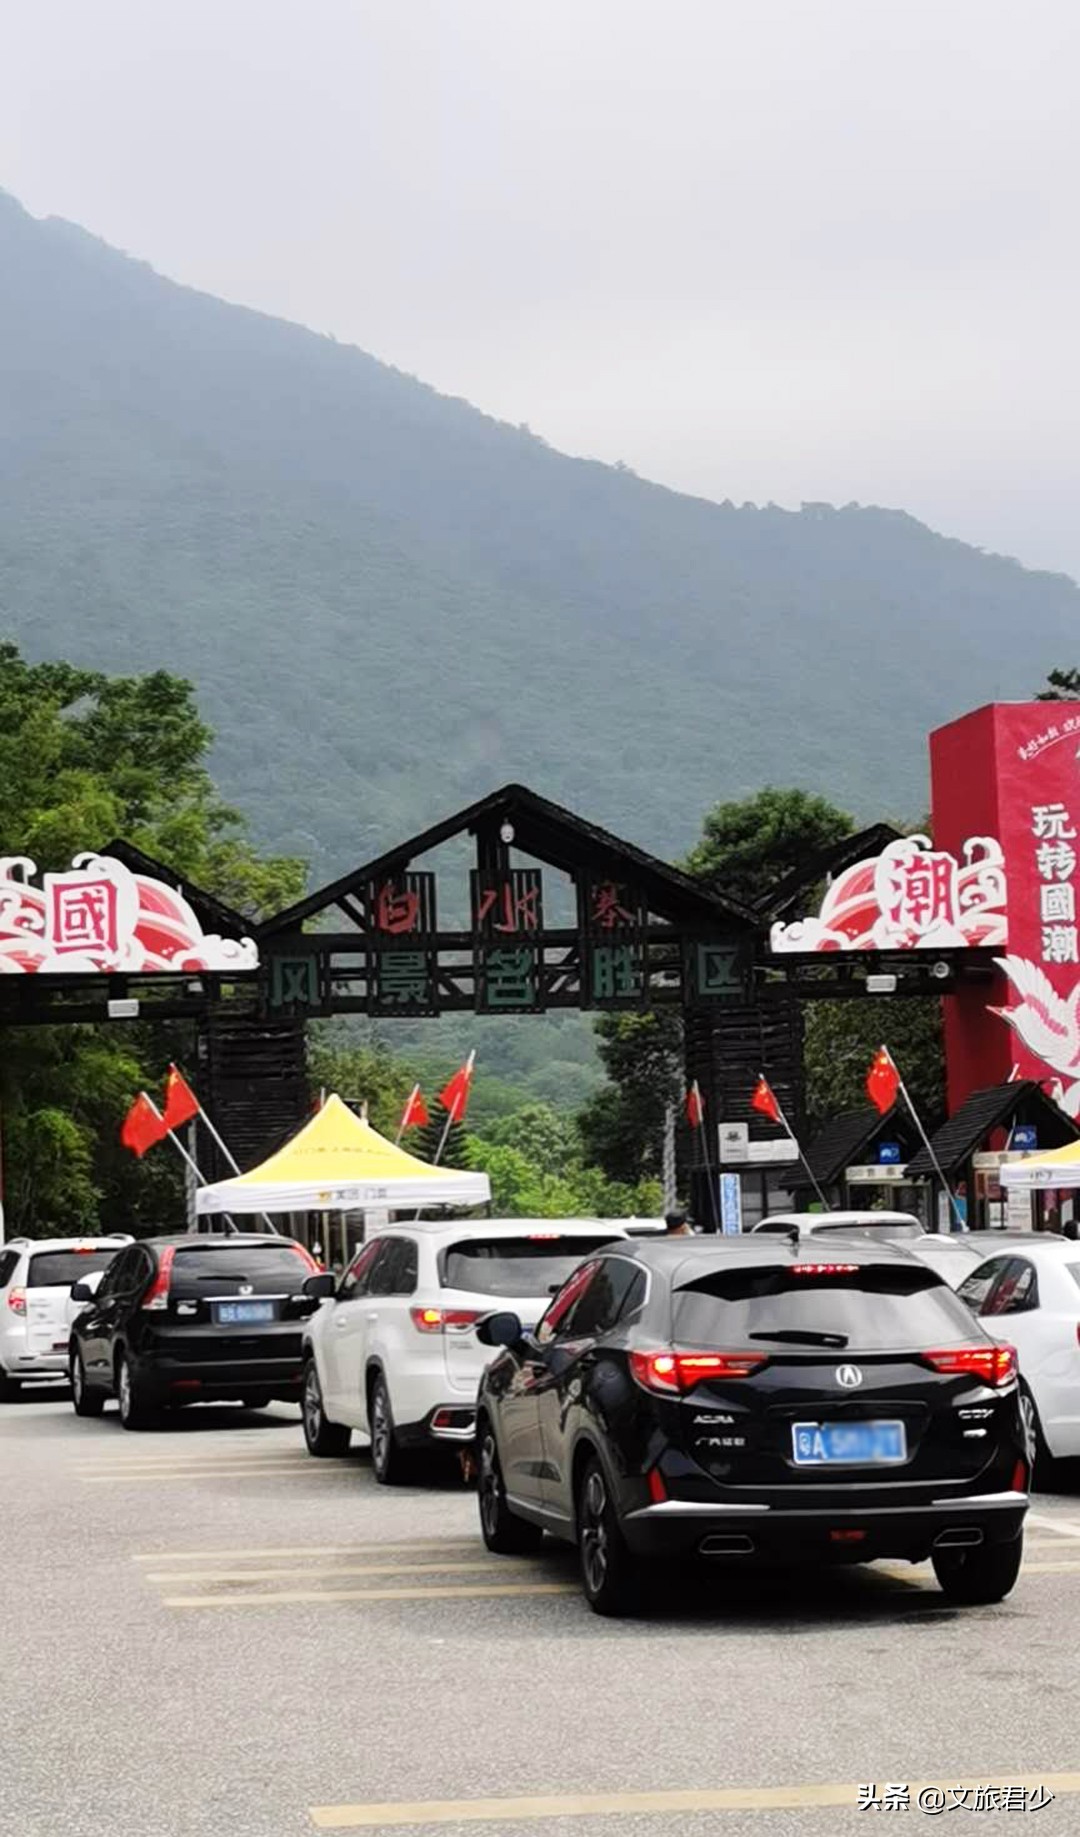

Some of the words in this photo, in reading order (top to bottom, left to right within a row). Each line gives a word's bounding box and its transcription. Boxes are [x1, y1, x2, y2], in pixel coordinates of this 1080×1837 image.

[52, 879, 118, 955] 國
[889, 854, 955, 926] 潮
[1031, 803, 1078, 964] 玩转國潮
[271, 943, 743, 1005] 风景名胜区
